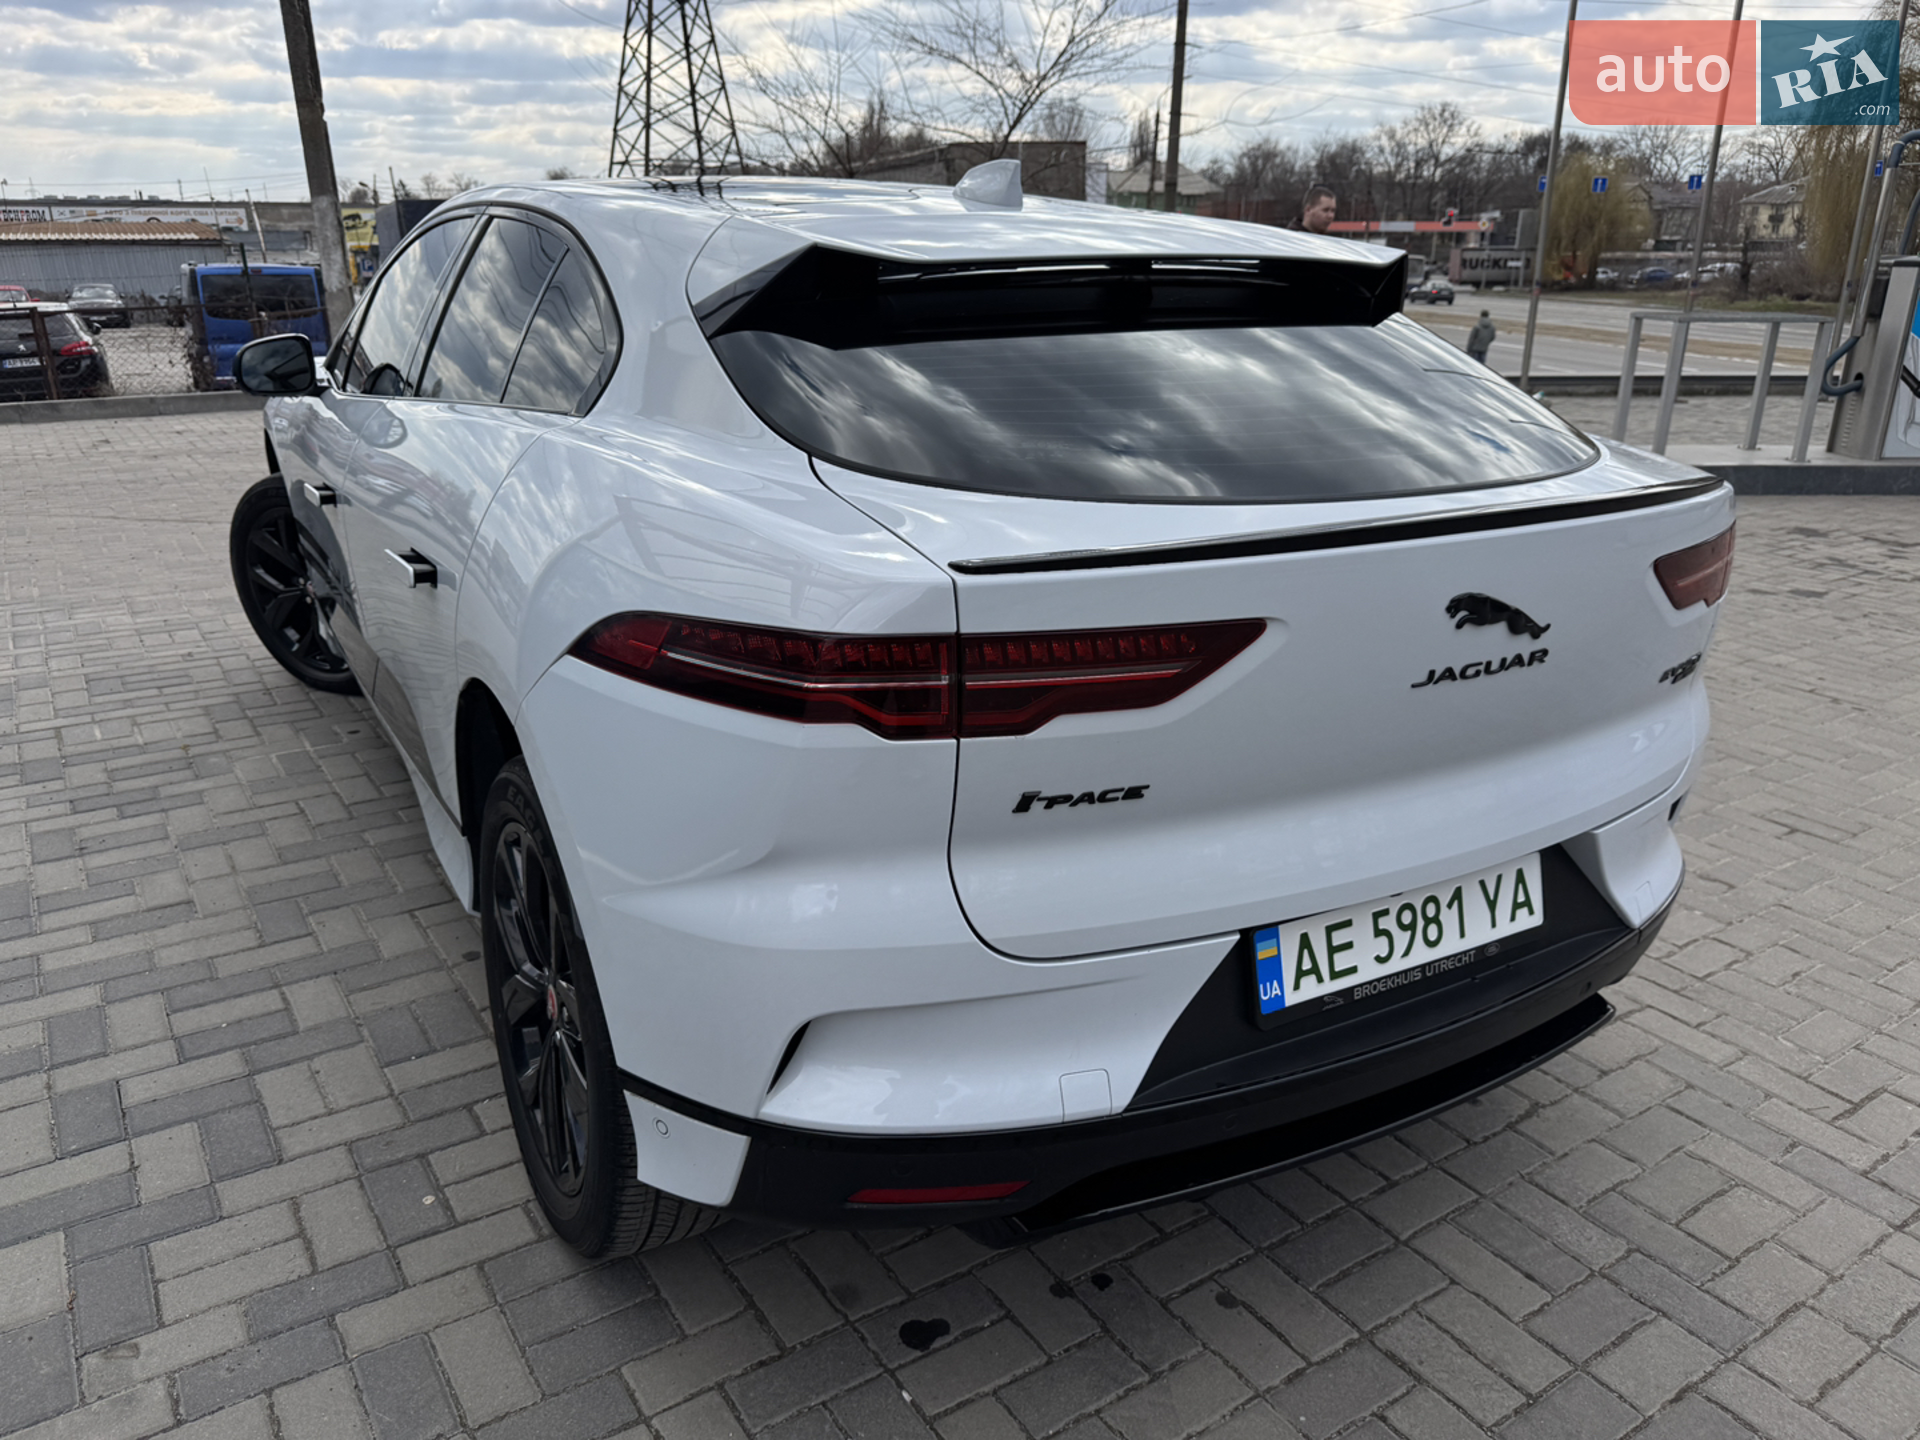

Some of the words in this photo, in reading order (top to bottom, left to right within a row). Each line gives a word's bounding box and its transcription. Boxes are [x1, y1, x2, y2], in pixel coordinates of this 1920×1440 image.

[1410, 648, 1549, 688] JAGUAR
[1293, 919, 1358, 992] AE
[1372, 885, 1466, 964] 5981
[1478, 867, 1535, 930] YA
[1260, 979, 1282, 1001] UA
[1353, 966, 1422, 1000] BROEKHUIS
[1425, 950, 1476, 977] UTRECHT
